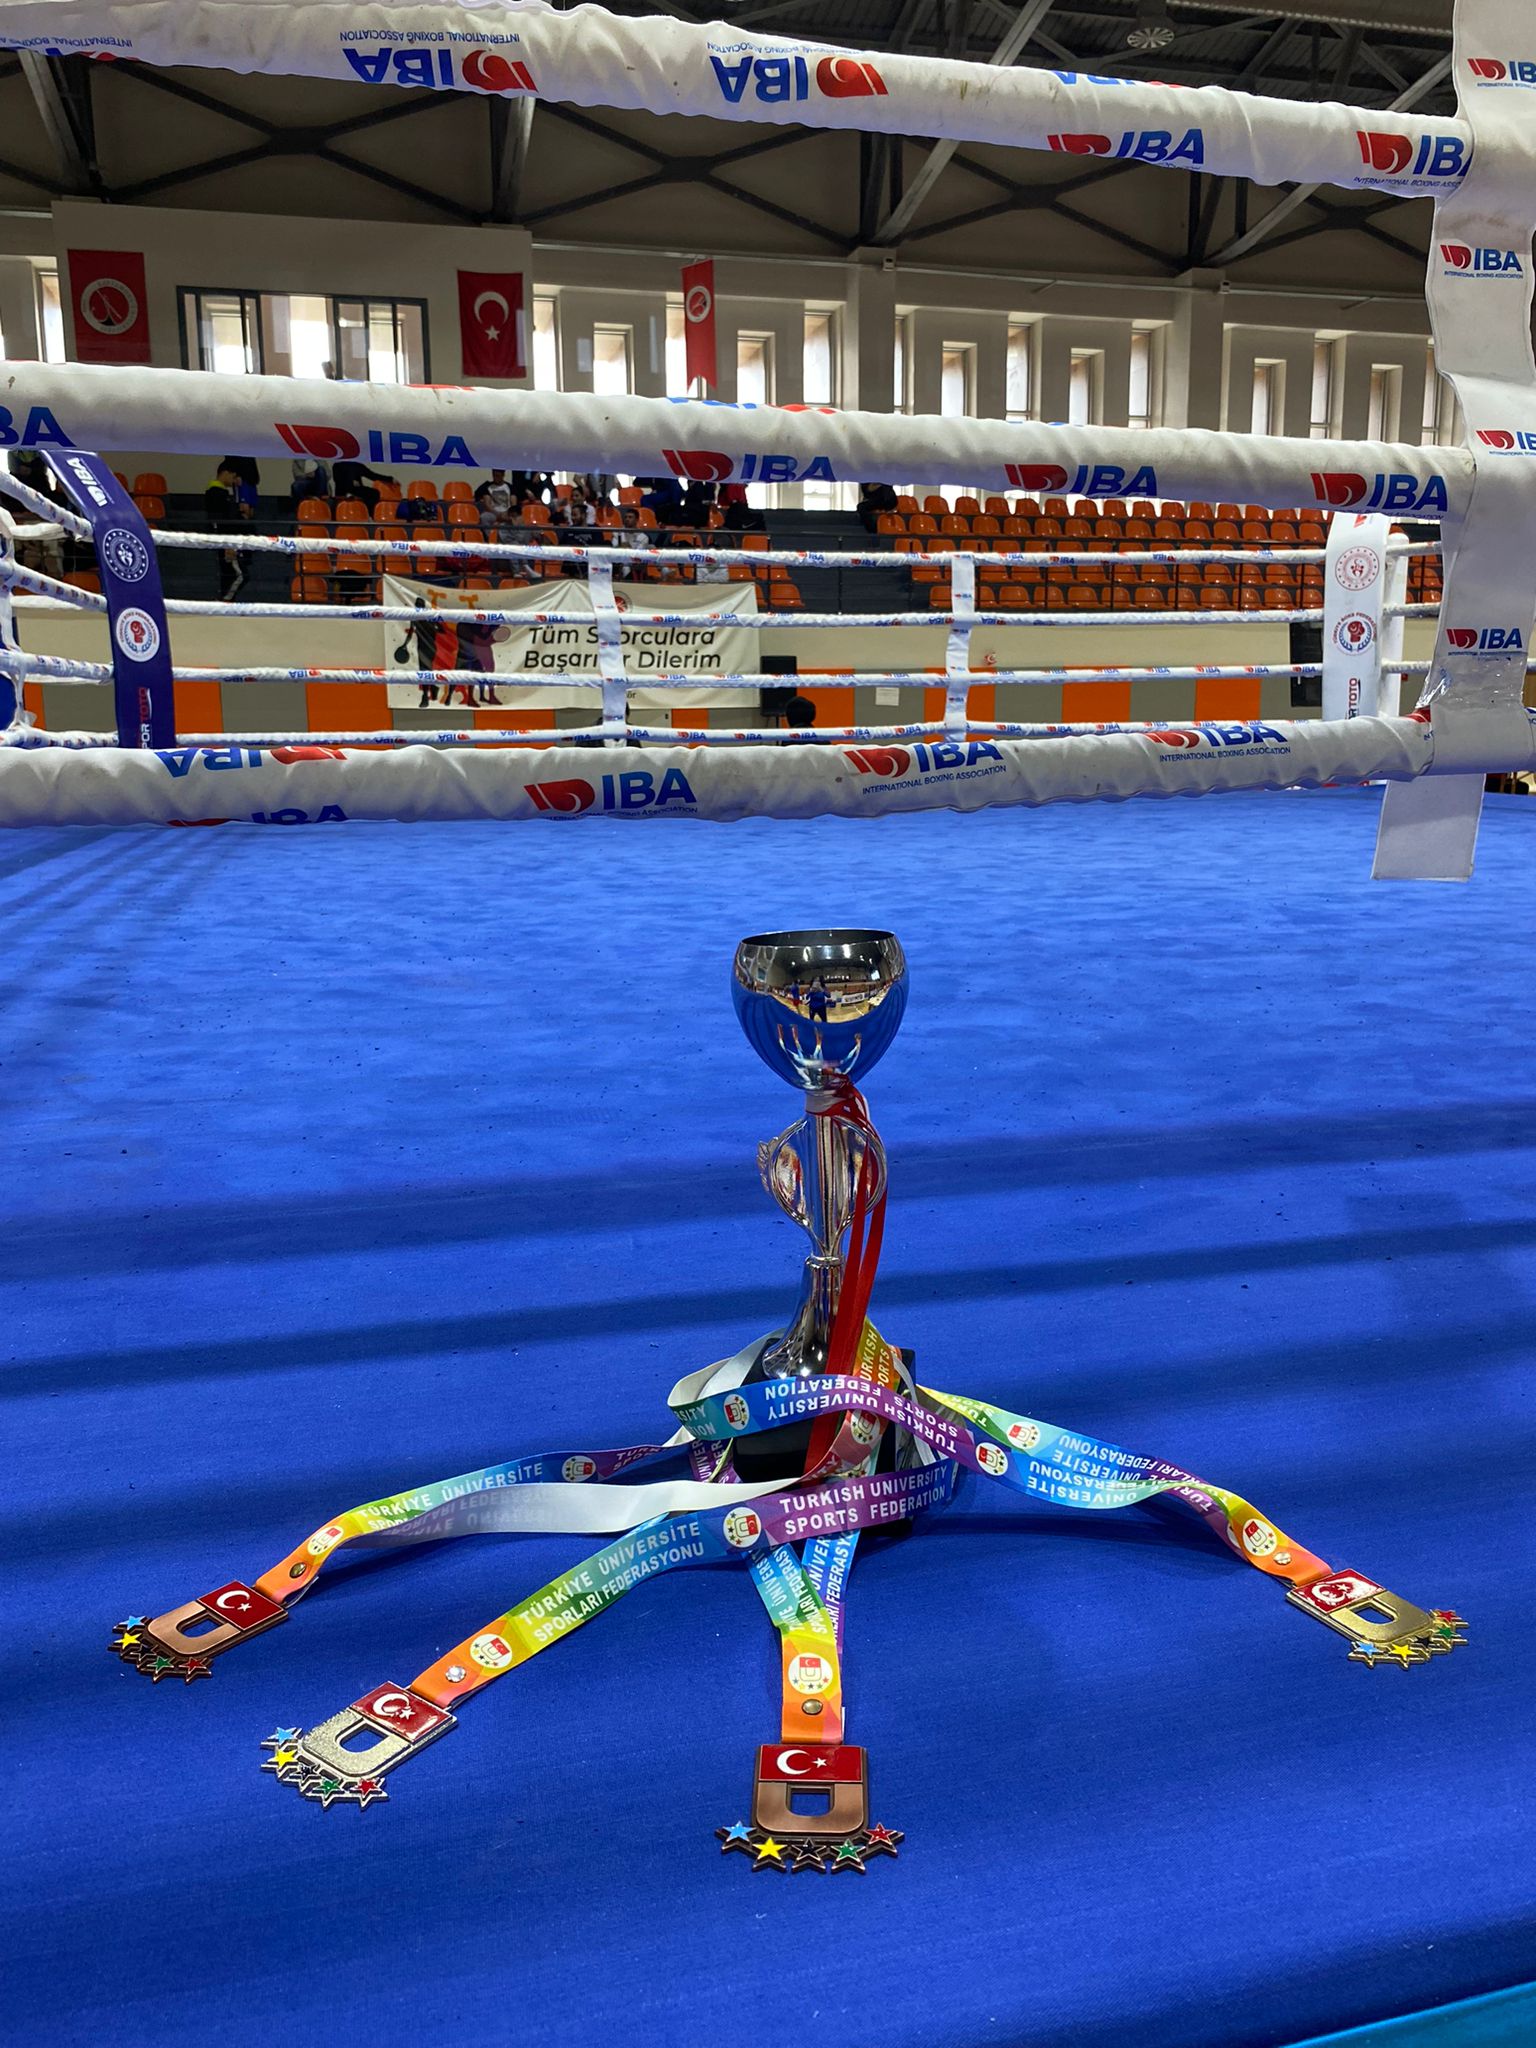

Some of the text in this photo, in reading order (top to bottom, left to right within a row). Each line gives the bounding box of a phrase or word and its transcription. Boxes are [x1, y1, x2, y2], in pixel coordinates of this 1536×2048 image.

[340, 30, 520, 44] INTERNATIONAL BOXING ASSOCIATION
[342, 47, 455, 87] IBA
[709, 55, 809, 103] IBA
[1508, 61, 1536, 83] IB
[1116, 128, 1204, 165] IBA
[1473, 248, 1523, 272] IBA
[367, 429, 480, 467] IBA
[740, 453, 837, 483] IBA
[1070, 464, 1158, 497] IBA
[1366, 473, 1448, 512] IBA
[487, 613, 506, 622] IBA
[548, 615, 566, 623] IBA
[663, 615, 682, 624] IBA
[528, 625, 716, 646] Tüm Sorculara
[1479, 627, 1523, 650] IBA
[523, 649, 722, 673] Başarır Dilerim
[1348, 677, 1358, 708] TOTO
[632, 729, 651, 738] IBA
[687, 731, 707, 741] IBA
[746, 733, 763, 741] IBA
[800, 732, 818, 740] IBA
[1199, 725, 1288, 748] IBA
[912, 741, 1005, 773] IBA
[1159, 751, 1217, 763] INTERNATIONAL
[1217, 750, 1245, 760] BOXING
[601, 767, 697, 811] IBA
[862, 764, 1007, 796] INTERNATIONAL BOXING ASSOCIATION
[859, 1329, 879, 1382] URKISH
[765, 1377, 882, 1402] FEDERATION
[768, 1391, 879, 1422] UNIVERSITY
[893, 1395, 958, 1438] SPORTS
[884, 1402, 958, 1455] TURKISH
[1059, 1434, 1158, 1472] FEDERASYONU
[359, 1492, 434, 1519] TÜRKİYE
[440, 1461, 544, 1503] ÜNİVERSİTE
[779, 1484, 866, 1514] TURKISH
[869, 1465, 949, 1498] UNIVERSITY
[784, 1485, 946, 1537] SPORTS FEDERATION
[520, 1521, 701, 1626] TÜRKİYE ÜNİVERSİTE
[533, 1541, 705, 1642] SPORLARI FEDERASYONU
